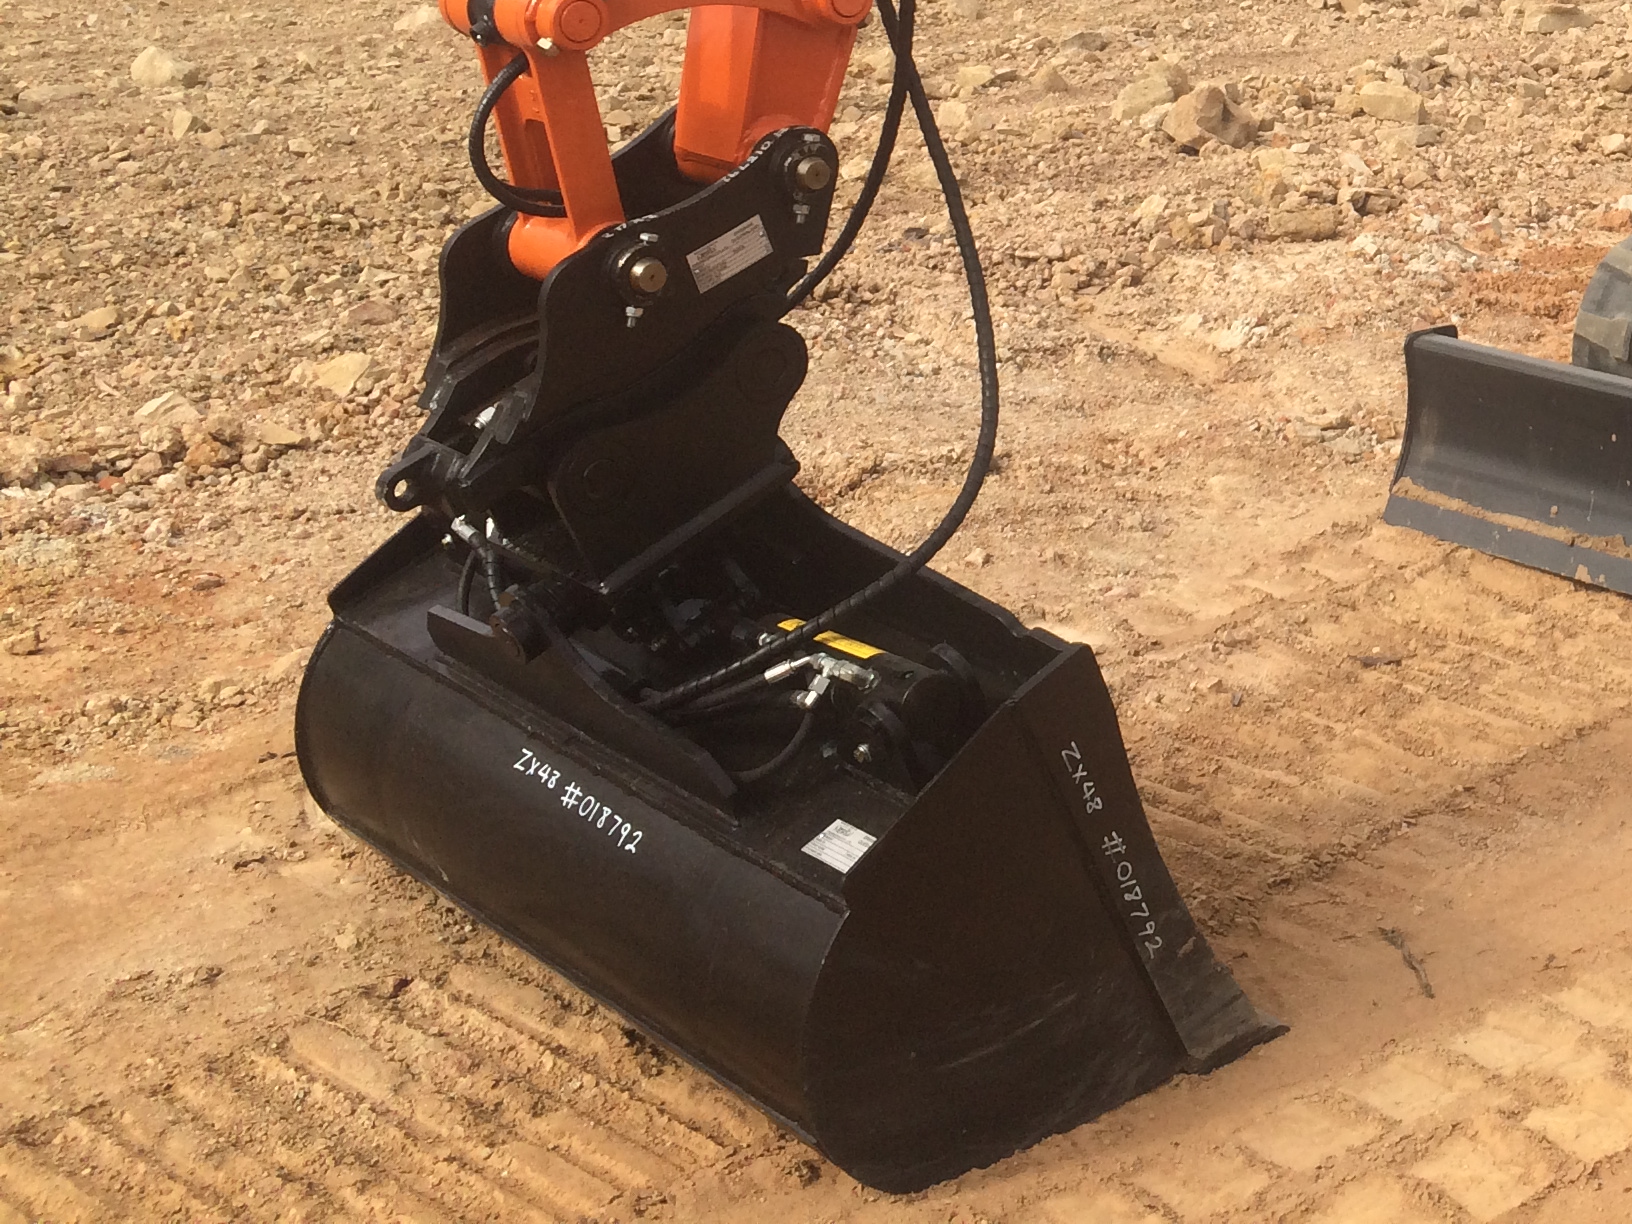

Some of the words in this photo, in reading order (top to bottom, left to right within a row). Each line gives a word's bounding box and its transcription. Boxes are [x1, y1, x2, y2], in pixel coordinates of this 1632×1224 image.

[513, 748, 561, 789] ZX48
[560, 781, 643, 854] #018792
[1061, 741, 1103, 813] ZX48
[1102, 831, 1163, 959] #018792
